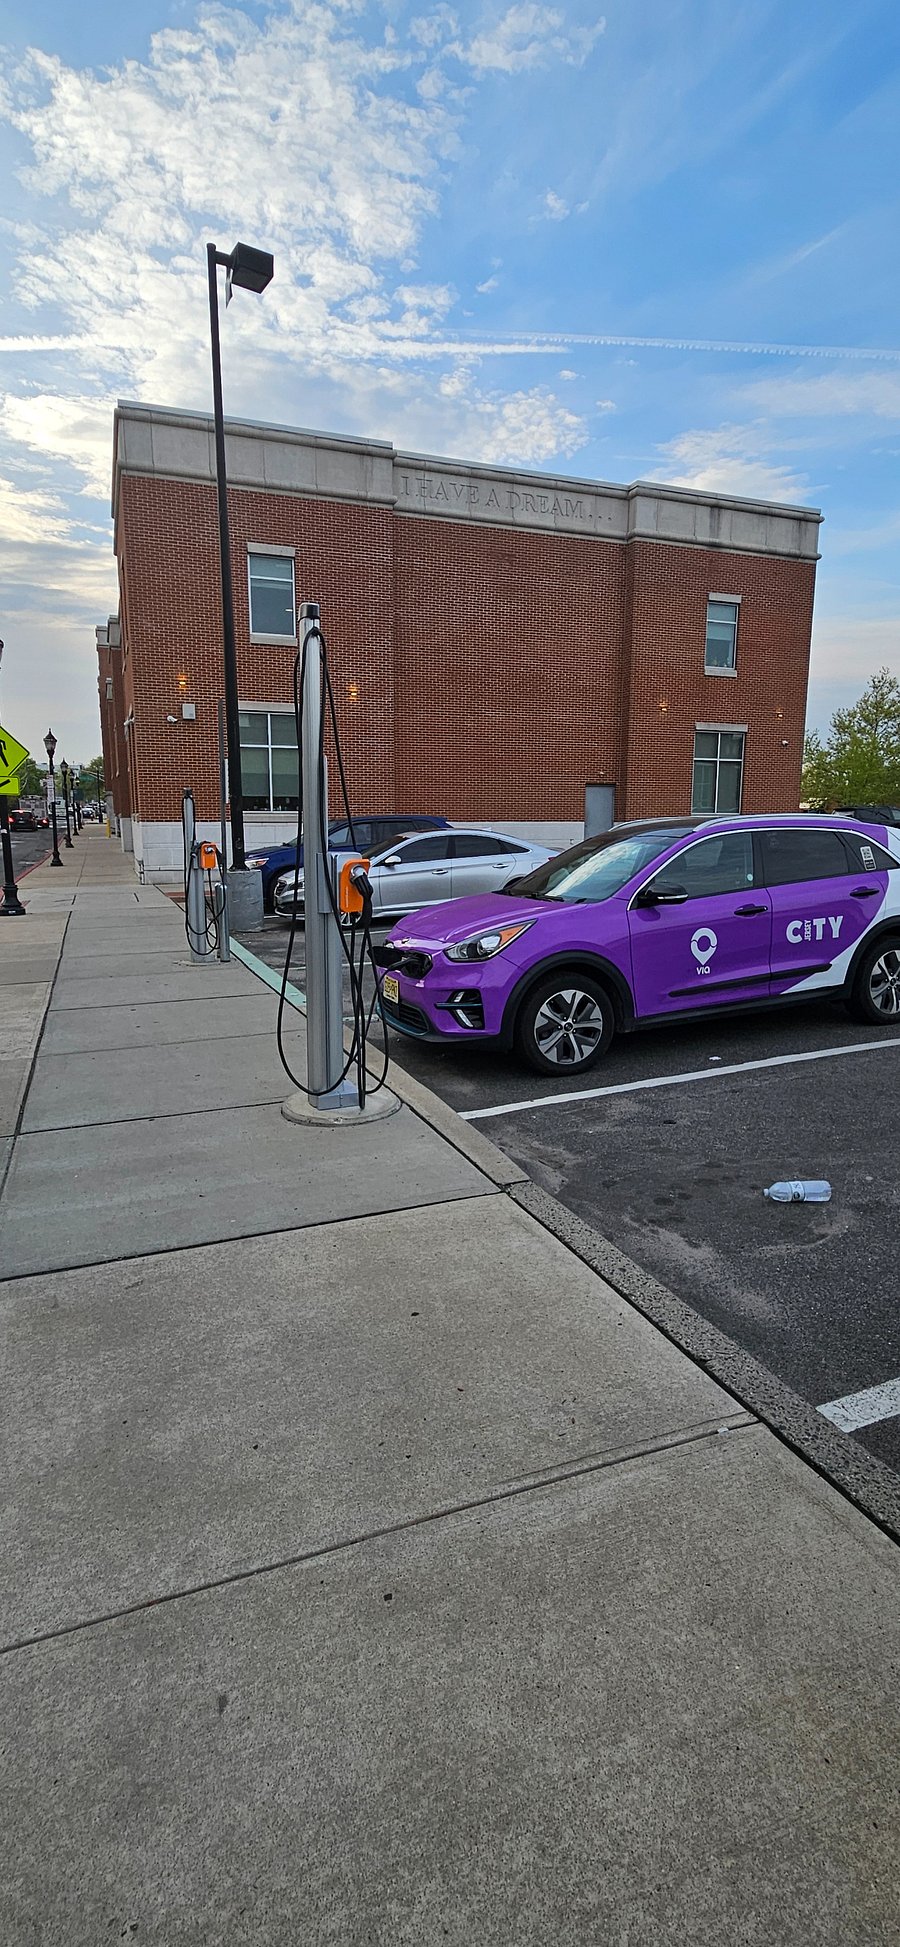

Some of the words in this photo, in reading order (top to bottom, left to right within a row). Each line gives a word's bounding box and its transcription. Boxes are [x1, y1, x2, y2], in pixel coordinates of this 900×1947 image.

[401, 475, 410, 496] I
[415, 477, 480, 504] HAVE
[485, 488, 501, 508] A
